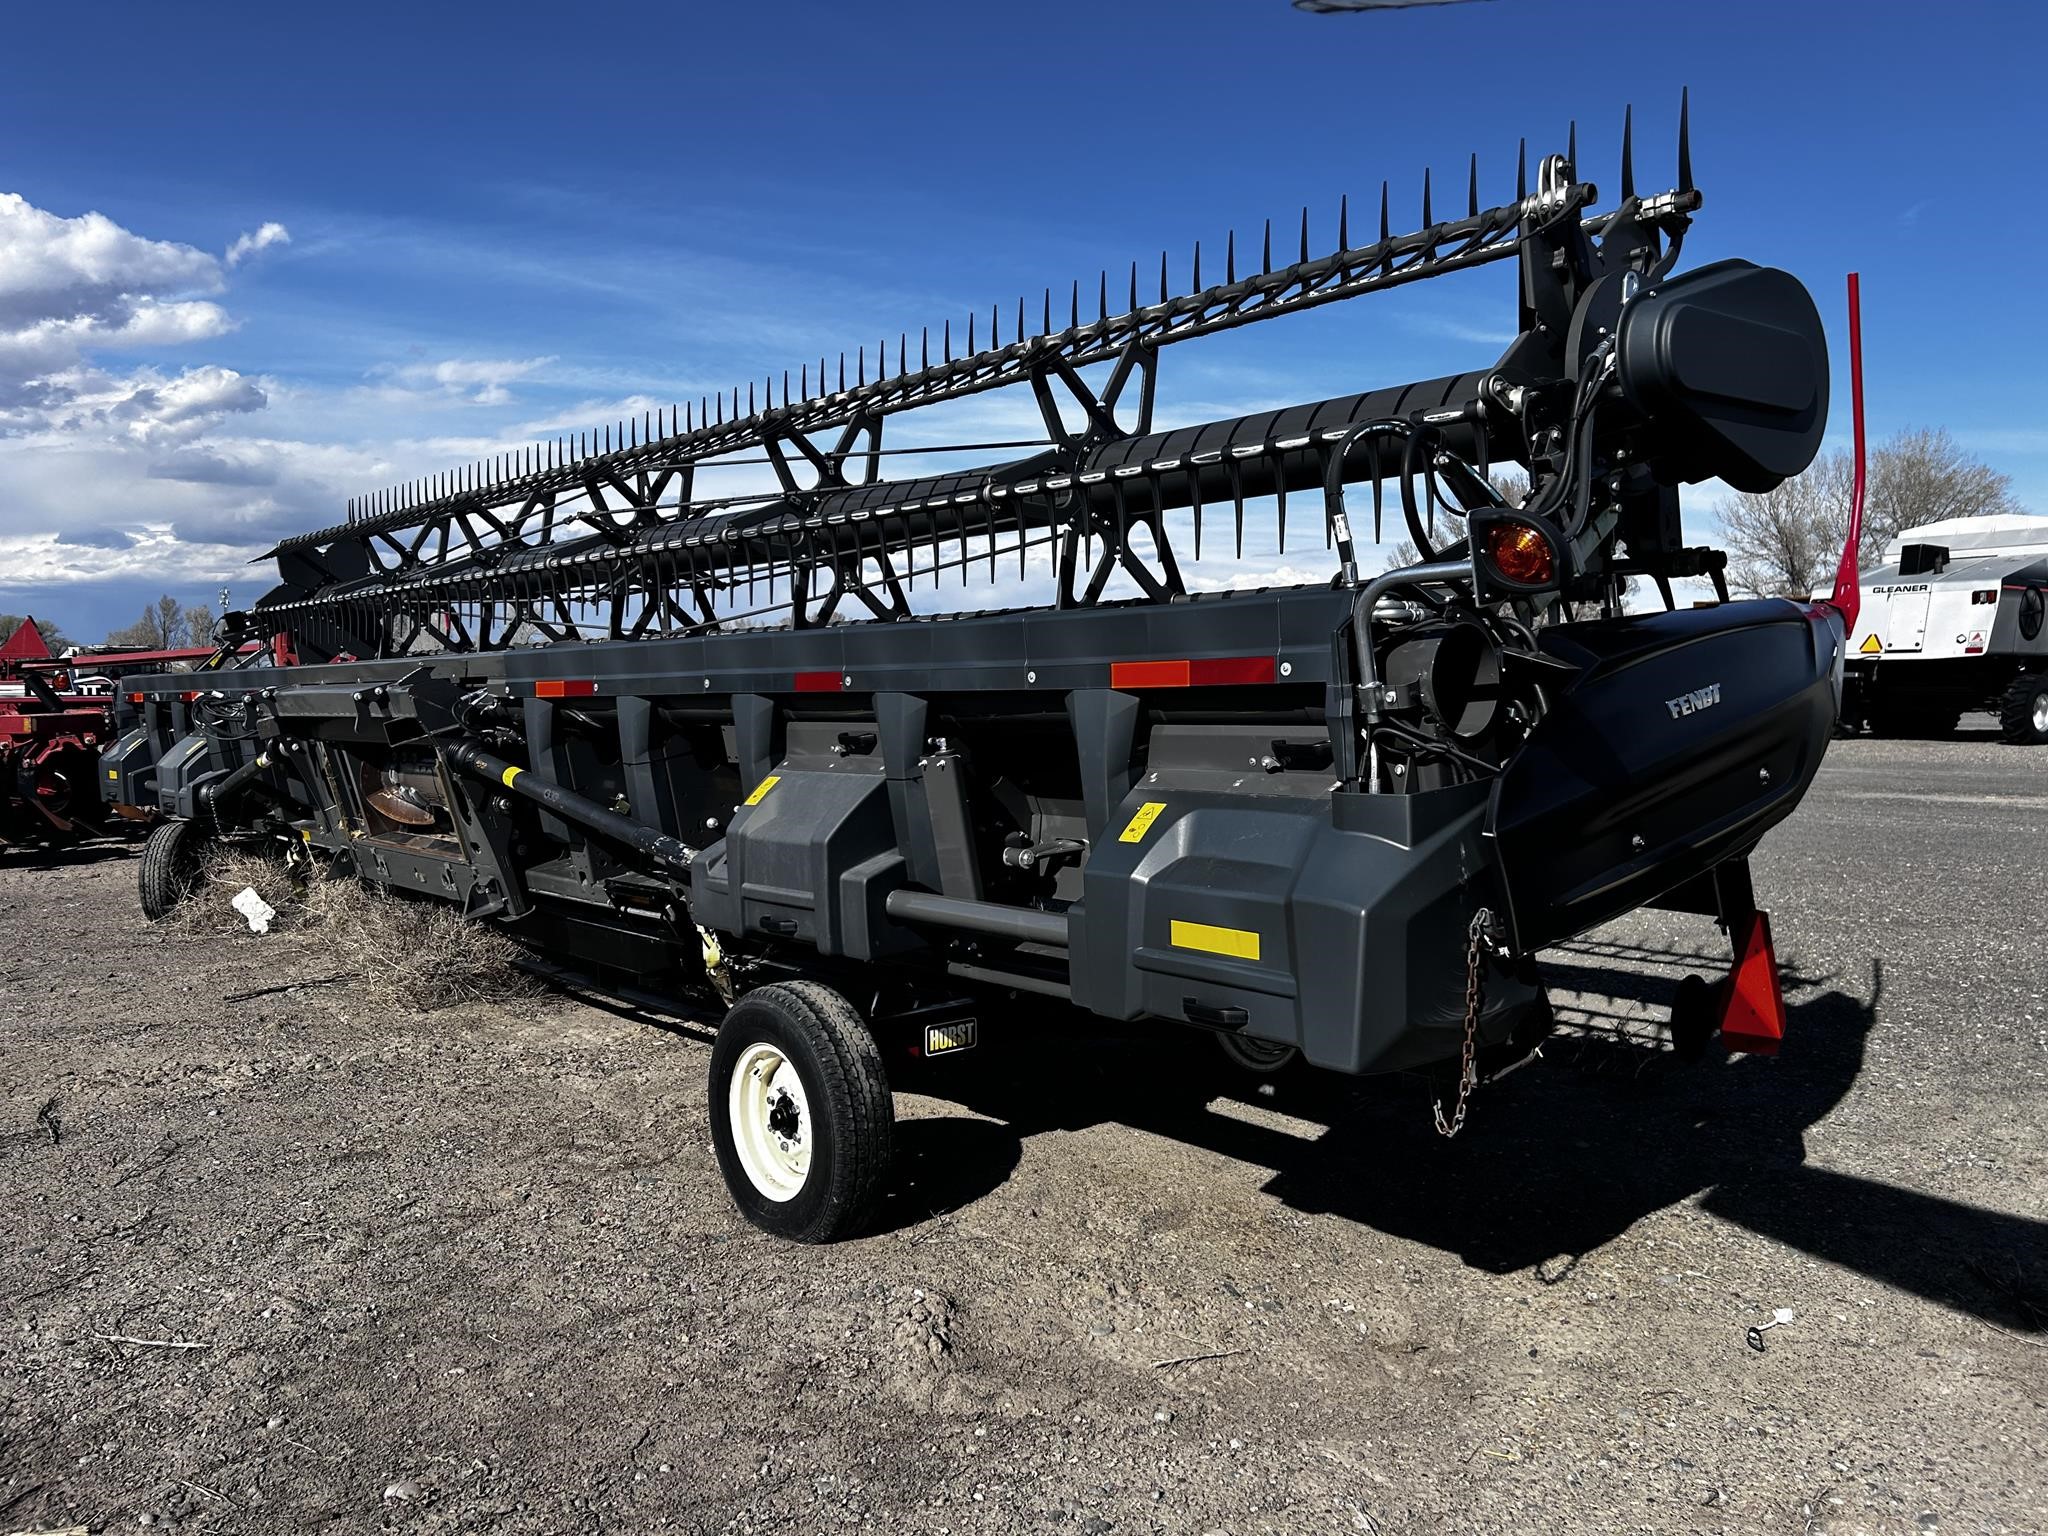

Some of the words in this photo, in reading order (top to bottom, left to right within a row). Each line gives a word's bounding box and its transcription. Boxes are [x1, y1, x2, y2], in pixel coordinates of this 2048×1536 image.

[1873, 584, 1928, 593] GLEANER
[1665, 682, 1720, 719] FENDT
[929, 1022, 974, 1051] HORST
